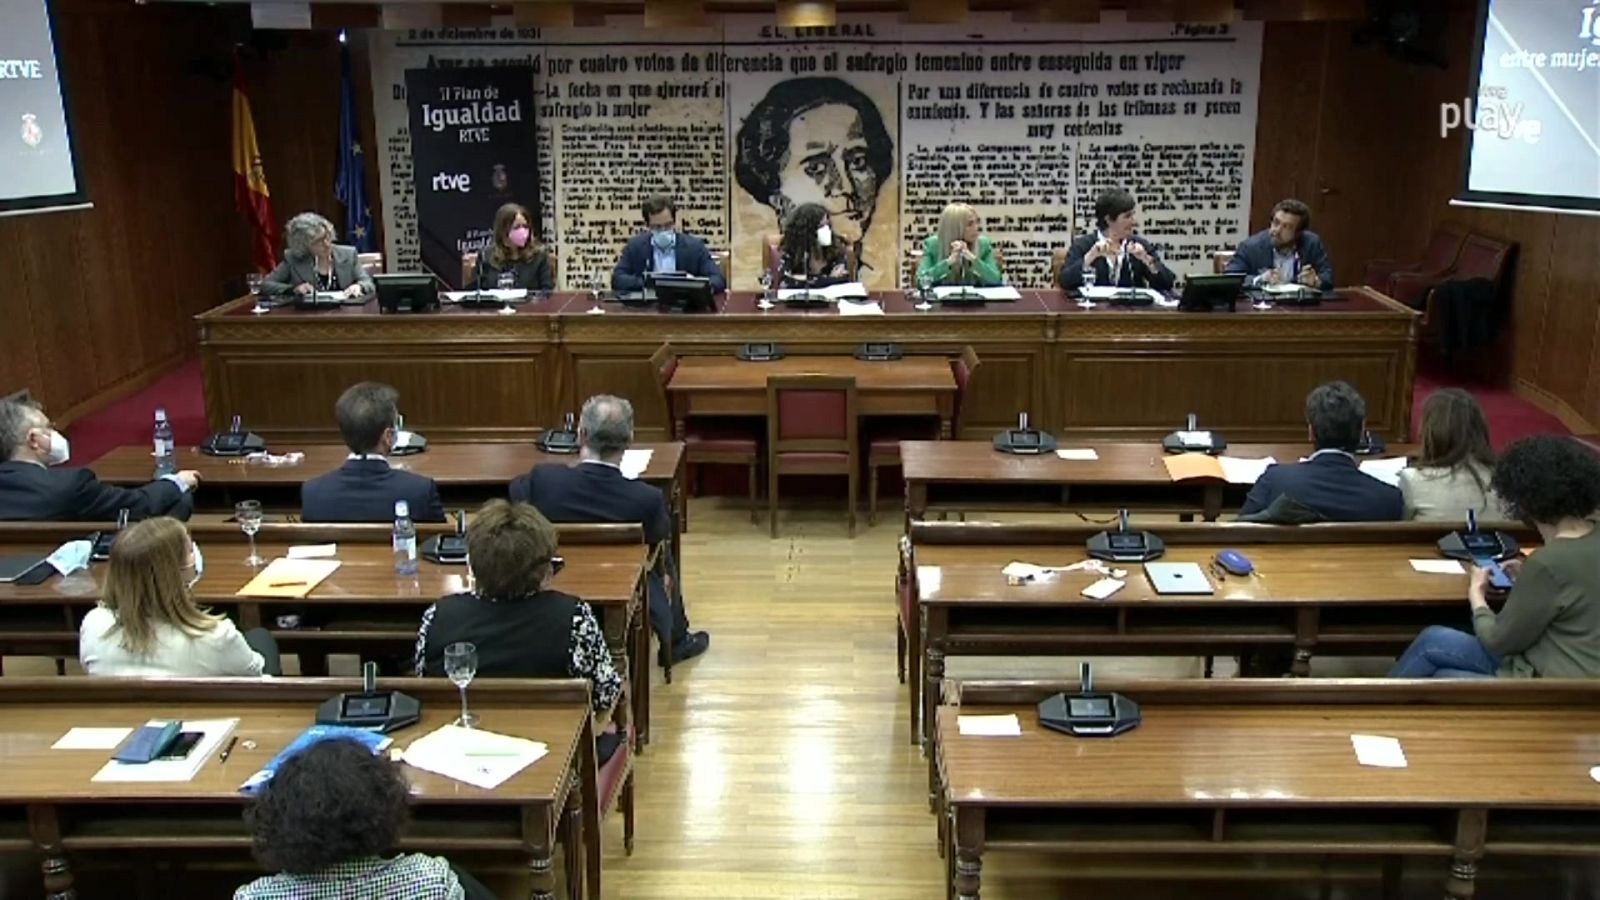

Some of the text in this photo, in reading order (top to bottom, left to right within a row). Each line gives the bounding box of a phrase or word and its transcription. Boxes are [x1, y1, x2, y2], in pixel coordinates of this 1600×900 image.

[420, 28, 435, 40] de
[437, 28, 497, 40] diciembre
[500, 28, 514, 40] de
[548, 58, 574, 76] por
[580, 55, 628, 73] cuatro
[634, 53, 675, 72] votos
[681, 53, 699, 72] de
[705, 51, 783, 73] diferencia
[790, 55, 816, 74] que
[824, 52, 838, 72] el
[846, 52, 908, 75] sufragio
[915, 52, 983, 72] femenino
[990, 53, 1032, 72] entre
[1037, 51, 1112, 74] enseguida
[1119, 54, 1138, 71] en
[1144, 51, 1187, 74] vigor
[1500, 50, 1547, 67] entre
[453, 86, 481, 100] Plan
[484, 85, 499, 99] de
[568, 81, 600, 98] fecha
[606, 83, 621, 98] en
[629, 83, 651, 101] que
[715, 81, 725, 98] el
[938, 85, 961, 100] una
[966, 81, 1030, 100] diferencia
[1039, 82, 1052, 99] de
[1058, 79, 1098, 98] cuatro
[1107, 80, 1139, 96] votos
[1144, 83, 1157, 96] es
[1162, 78, 1224, 96] rechazada
[1230, 78, 1242, 95] la
[422, 100, 521, 132] Igualdad
[539, 101, 651, 119] sufragio la mujer
[979, 102, 990, 119] Y
[995, 102, 1015, 119] las
[1022, 103, 1072, 119] señoras
[1076, 101, 1090, 117] de
[1098, 101, 1117, 117] las
[1124, 99, 1176, 116] tribunas
[1184, 101, 1197, 115] se
[1204, 101, 1241, 118] ponen
[459, 127, 490, 143] RTVE
[1026, 123, 1055, 139] muy
[432, 171, 471, 193] rtve
